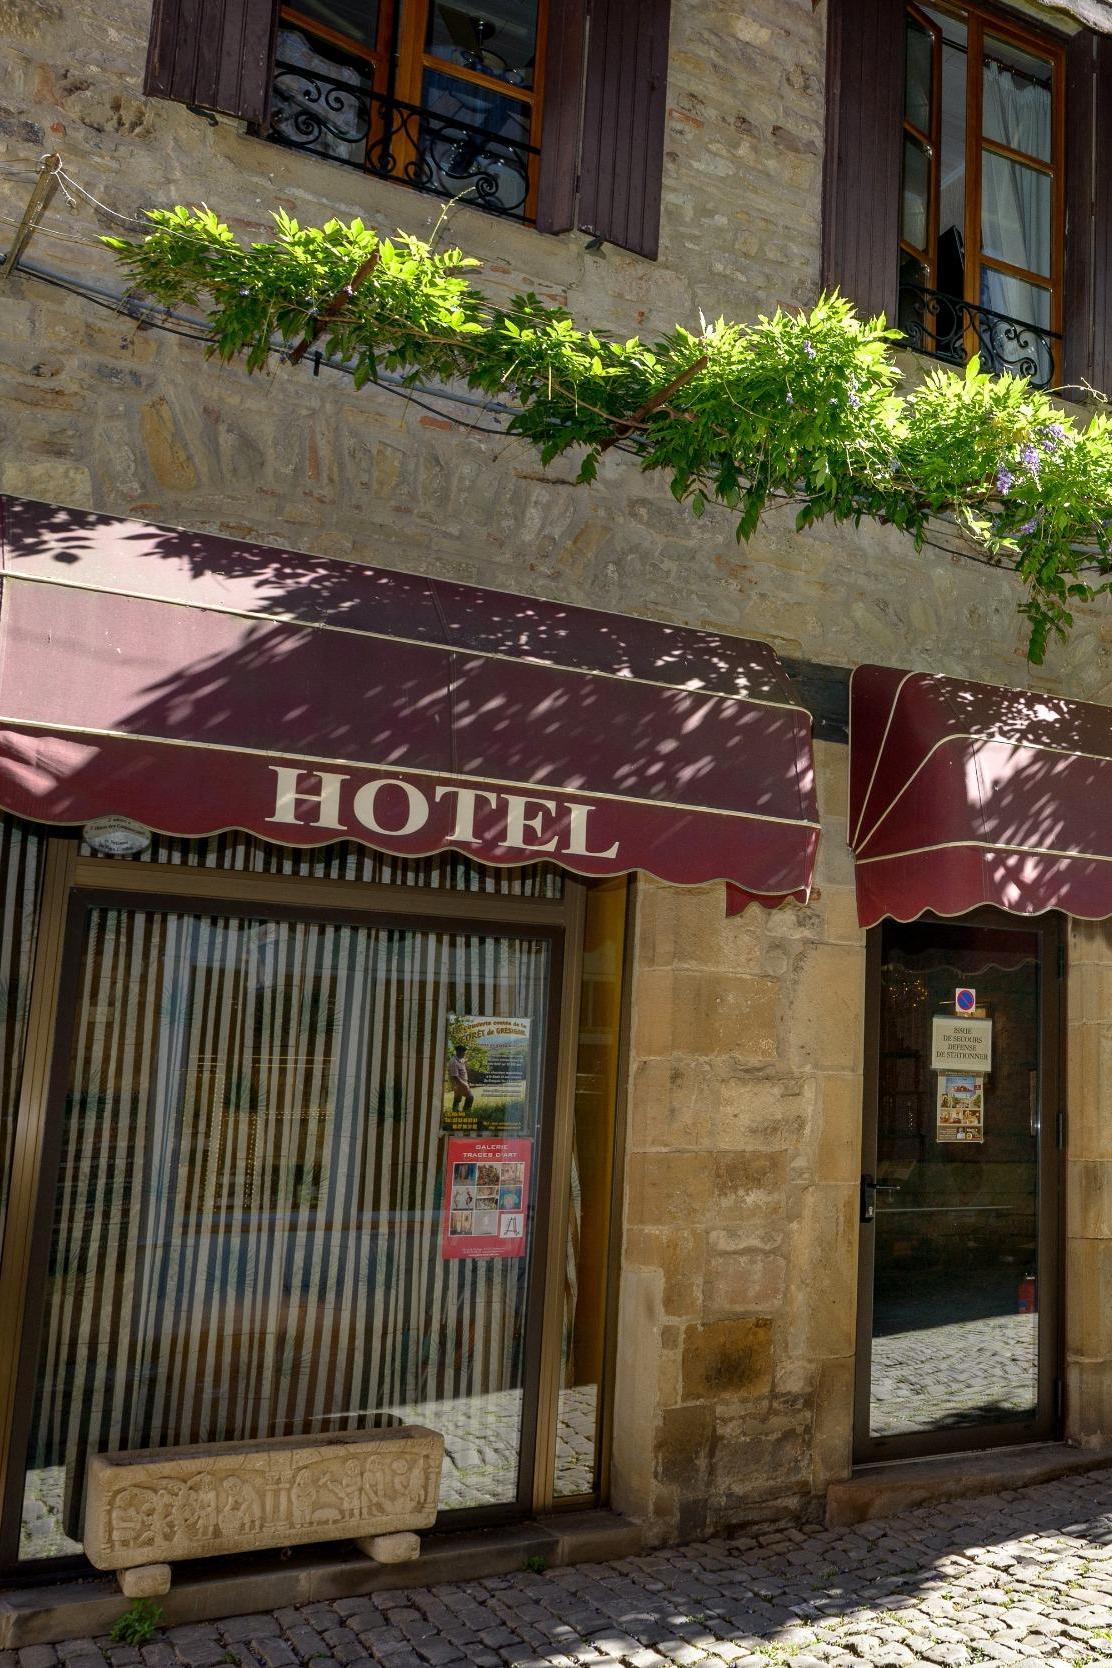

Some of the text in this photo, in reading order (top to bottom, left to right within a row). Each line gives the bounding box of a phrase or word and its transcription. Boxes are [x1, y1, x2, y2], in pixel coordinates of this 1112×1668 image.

[265, 765, 620, 859] HOTEL
[943, 1034, 952, 1042] DE
[936, 1050, 946, 1058] DE
